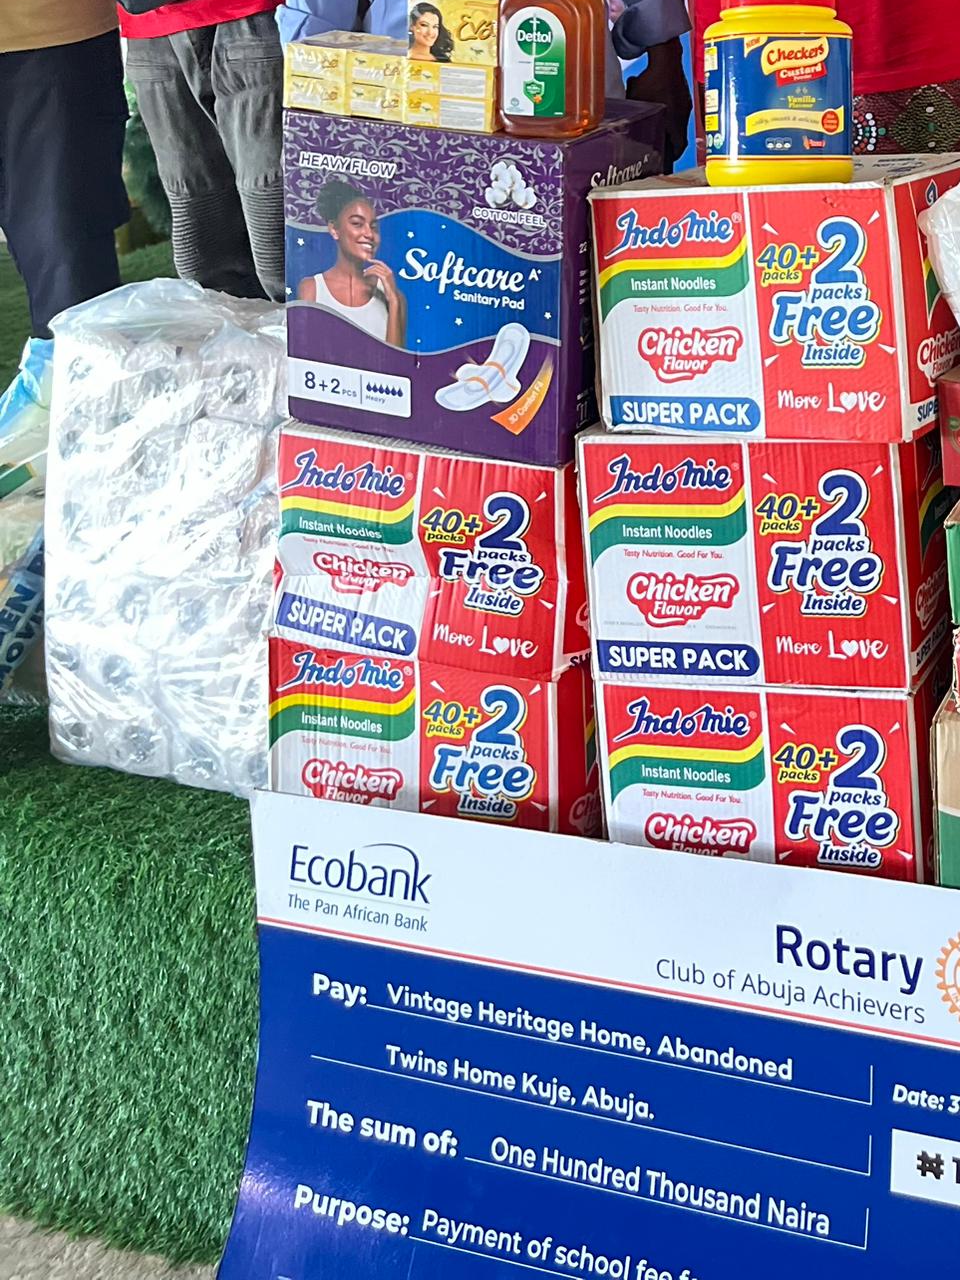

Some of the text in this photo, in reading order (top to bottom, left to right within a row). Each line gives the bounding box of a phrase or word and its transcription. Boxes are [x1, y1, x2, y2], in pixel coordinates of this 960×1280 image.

[455, 14, 497, 42] Eva
[517, 29, 552, 43] Dettol
[766, 43, 825, 66] Checkers
[780, 63, 822, 78] Custard
[298, 151, 398, 180] HEAVY FLOW
[472, 206, 546, 227] COTTON FEEL
[604, 208, 734, 260] Indomie
[398, 247, 526, 293] Softcare
[631, 276, 716, 292] Instant Noodles
[761, 267, 800, 286] packs
[453, 289, 525, 310] Sanitary Pad
[632, 303, 728, 313] Tasty Nutrition. Good For You.
[811, 284, 863, 305] packs
[773, 292, 877, 338] Free
[641, 329, 736, 358] Chicken
[804, 342, 862, 363] Inside
[663, 353, 709, 372] Flavor
[341, 388, 358, 398] PCS
[777, 381, 887, 414] More Love
[621, 399, 752, 426] SUPER PACK
[281, 449, 406, 497] Indomie
[299, 516, 382, 540] Instant Noodles
[622, 523, 713, 540] Instant Noodles
[623, 549, 725, 559] Tasty Nutrition. Good For You.
[442, 551, 540, 589] Free
[467, 589, 522, 613] Inside
[630, 574, 732, 603] Chicken
[286, 600, 408, 652] SUPER PACK
[432, 622, 539, 659] More Love
[608, 645, 678, 668] SUPER
[682, 648, 750, 671] PACK
[641, 764, 731, 784] Instant Noodles
[779, 769, 820, 784] packs
[289, 842, 432, 904] Ecobank
[287, 893, 428, 933] The Pan African Bank
[774, 923, 924, 995] Rotary
[655, 958, 926, 1024] Club of Abuja Achievers
[311, 972, 794, 1082] Pay: Vintage Heritage Home, Abandoned
[385, 1043, 656, 1122] Twins Home Kuje, Abuja.
[891, 1083, 945, 1114] Date:
[306, 1099, 831, 1238] The sum of: One Hundred Thousand Naira
[293, 1182, 631, 1280] Purpose: Payment of school
